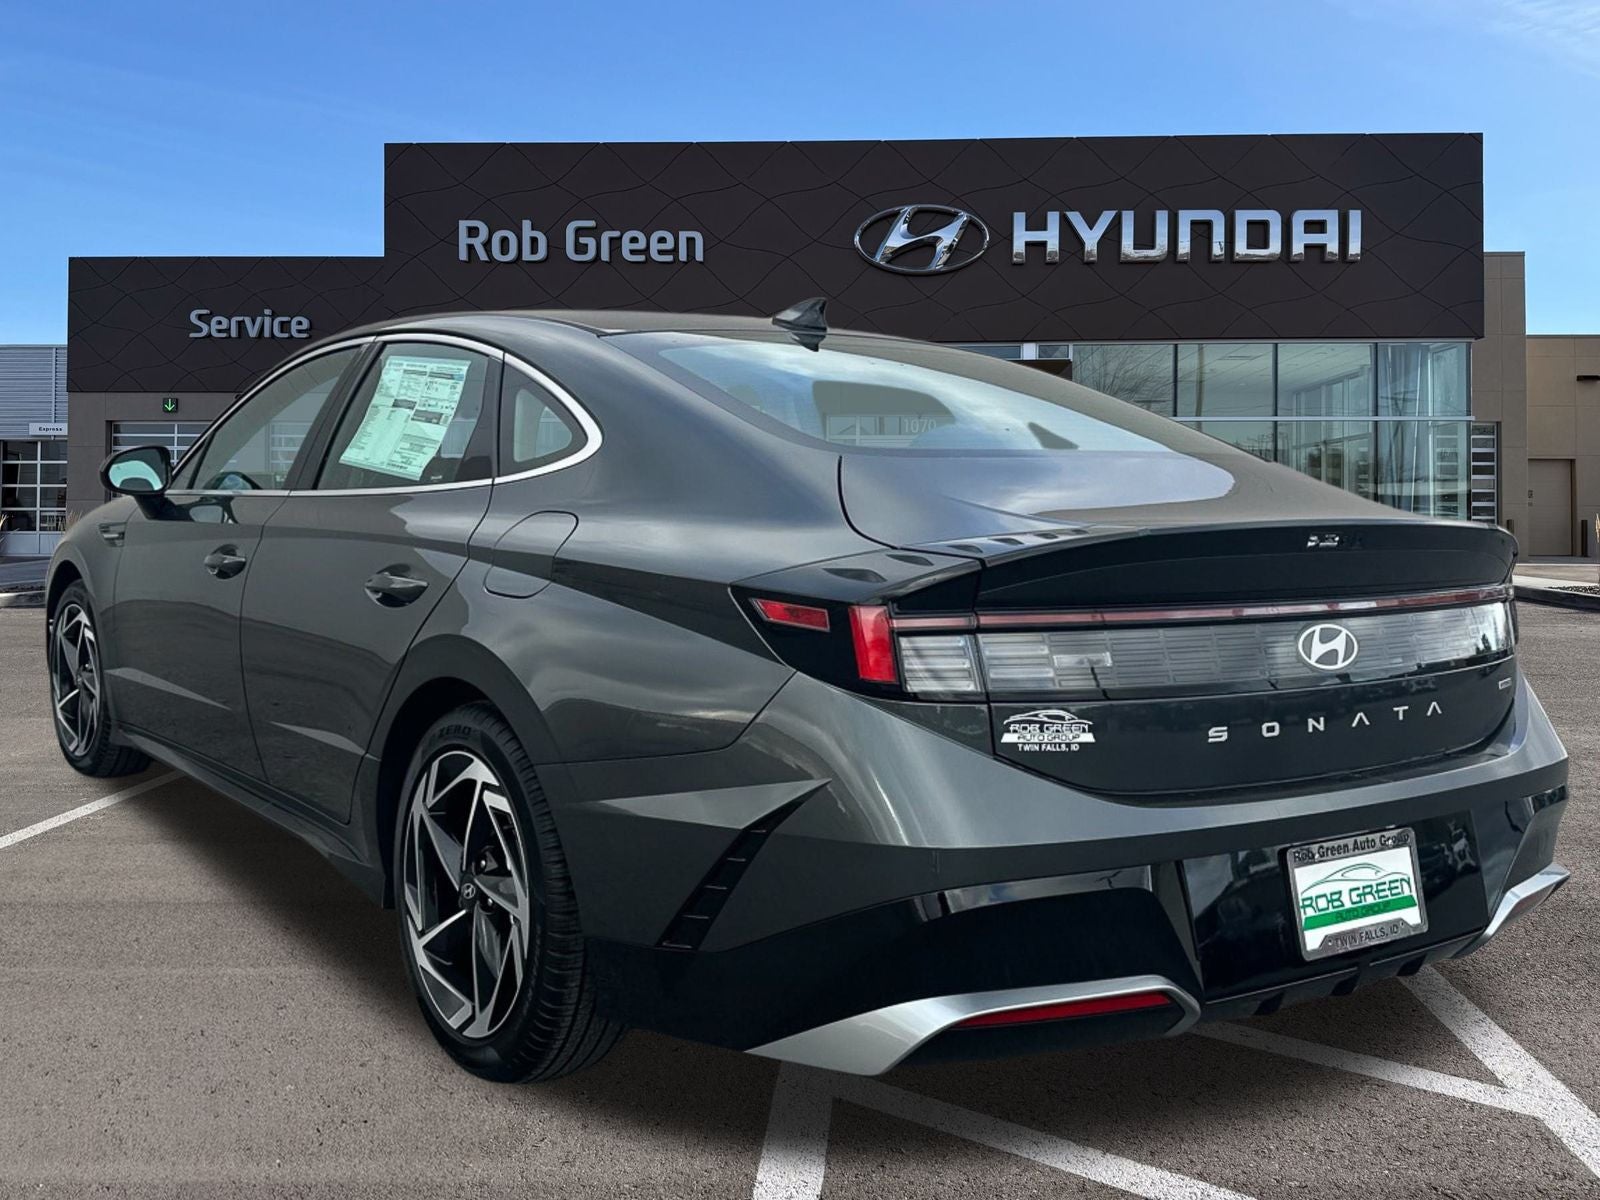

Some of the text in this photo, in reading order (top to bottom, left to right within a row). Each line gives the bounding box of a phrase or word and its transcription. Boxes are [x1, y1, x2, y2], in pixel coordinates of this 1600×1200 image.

[458, 219, 704, 263] Rob Green
[1011, 208, 1363, 264] HYUNDAI
[189, 308, 311, 339] Service
[1009, 723, 1089, 734] ROB GREEN
[1207, 701, 1442, 743] SONATA
[1017, 744, 1039, 752] TWIN
[1041, 744, 1069, 752] FALLS,
[1293, 832, 1410, 862] Rob Green Auto Group
[1301, 877, 1413, 915] ROB GREEN
[1335, 934, 1357, 948] TWIN
[1390, 924, 1399, 934] ID
